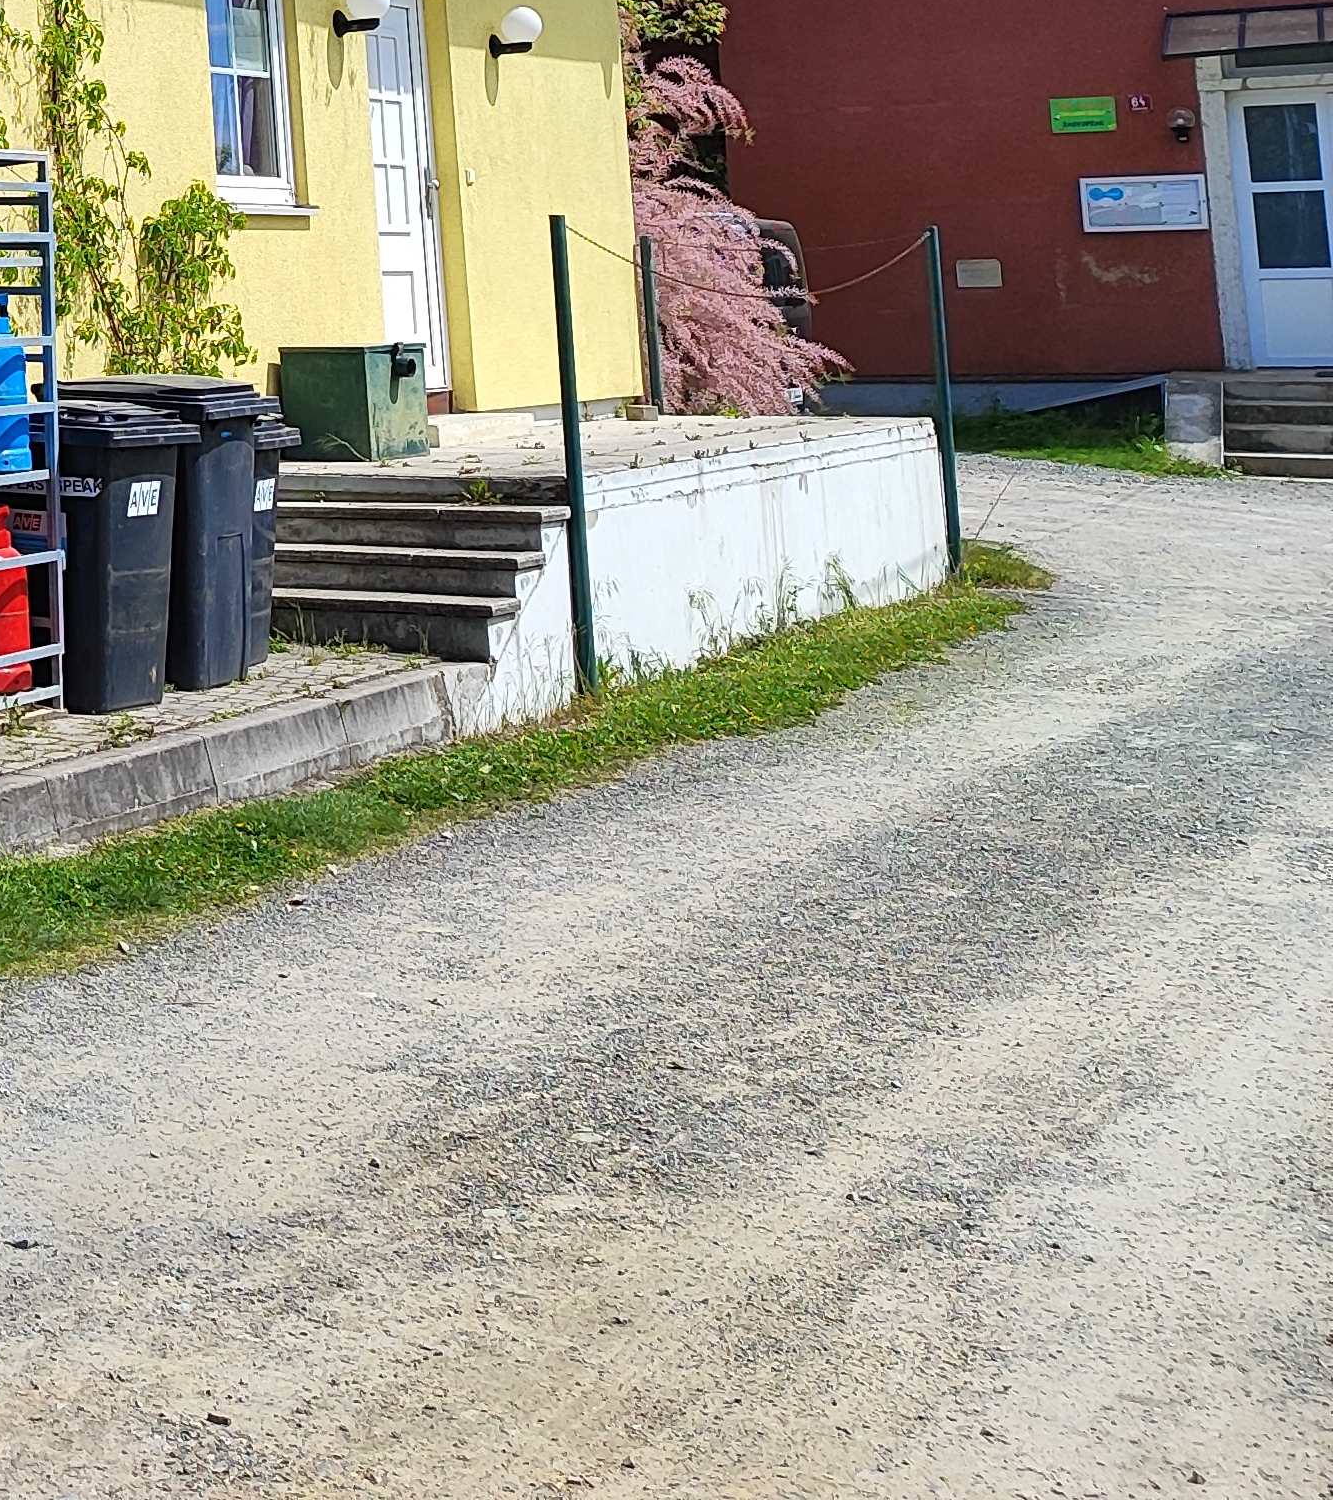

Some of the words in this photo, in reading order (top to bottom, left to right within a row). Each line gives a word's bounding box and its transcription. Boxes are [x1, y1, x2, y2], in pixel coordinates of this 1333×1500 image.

[1130, 96, 1146, 107] 64
[129, 488, 158, 509] AVE
[256, 486, 274, 502] AVE
[13, 515, 41, 529] AVE
